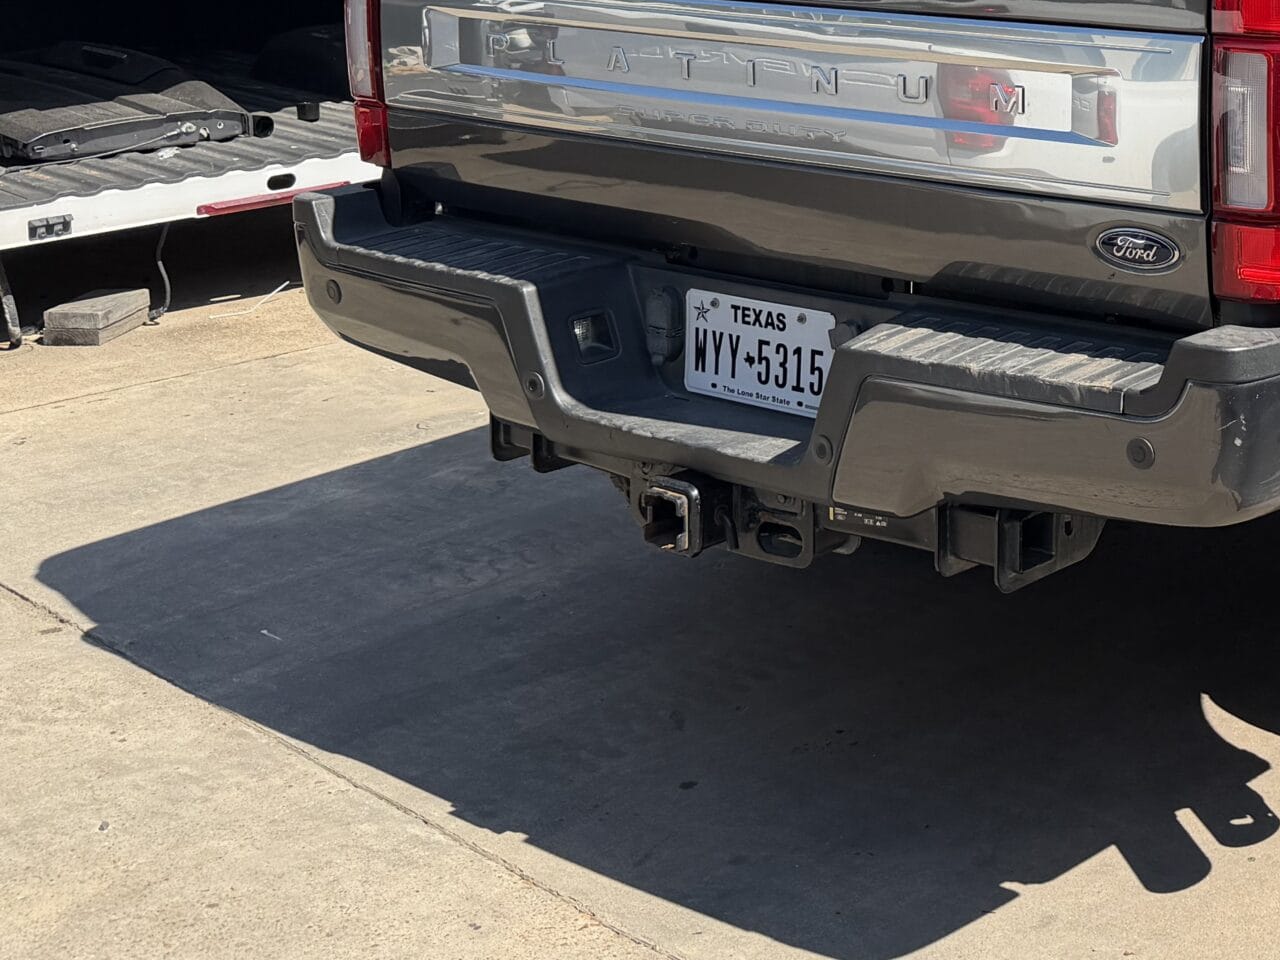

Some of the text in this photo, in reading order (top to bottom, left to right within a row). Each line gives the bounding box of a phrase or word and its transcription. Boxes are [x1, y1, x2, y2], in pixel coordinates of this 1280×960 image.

[487, 32, 1026, 115] PLATINUM
[1113, 236, 1157, 262] Ford
[731, 304, 787, 332] TEXAS
[722, 385, 791, 406] The Lone Star State
